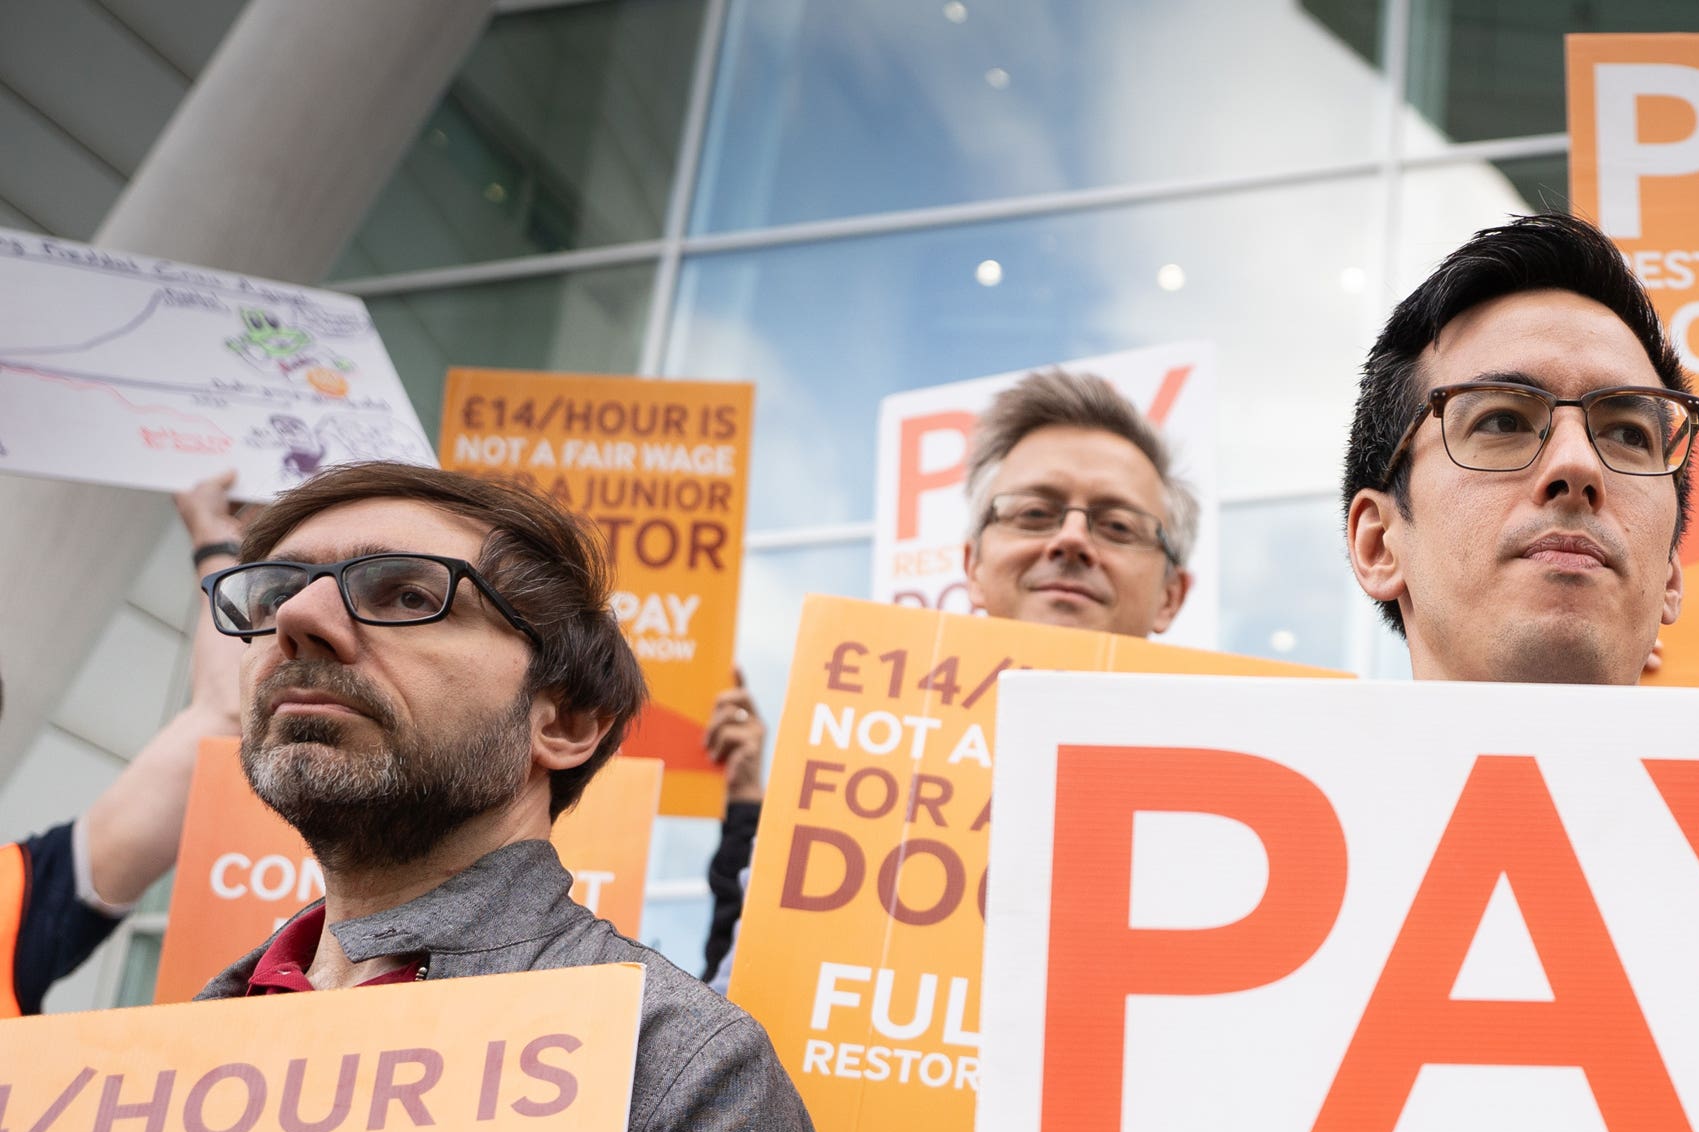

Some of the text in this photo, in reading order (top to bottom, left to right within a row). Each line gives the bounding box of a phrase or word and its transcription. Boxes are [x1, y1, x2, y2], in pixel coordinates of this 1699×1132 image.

[463, 396, 737, 441] £14/HOUR IS
[455, 434, 735, 476] NOT A FAIR WAGE
[583, 475, 732, 513] JUNIOR
[612, 591, 701, 636] PAY
[636, 638, 695, 662] NOW
[809, 703, 992, 769] NOT A
[798, 760, 949, 828] FOR
[475, 1032, 584, 1122] IS
